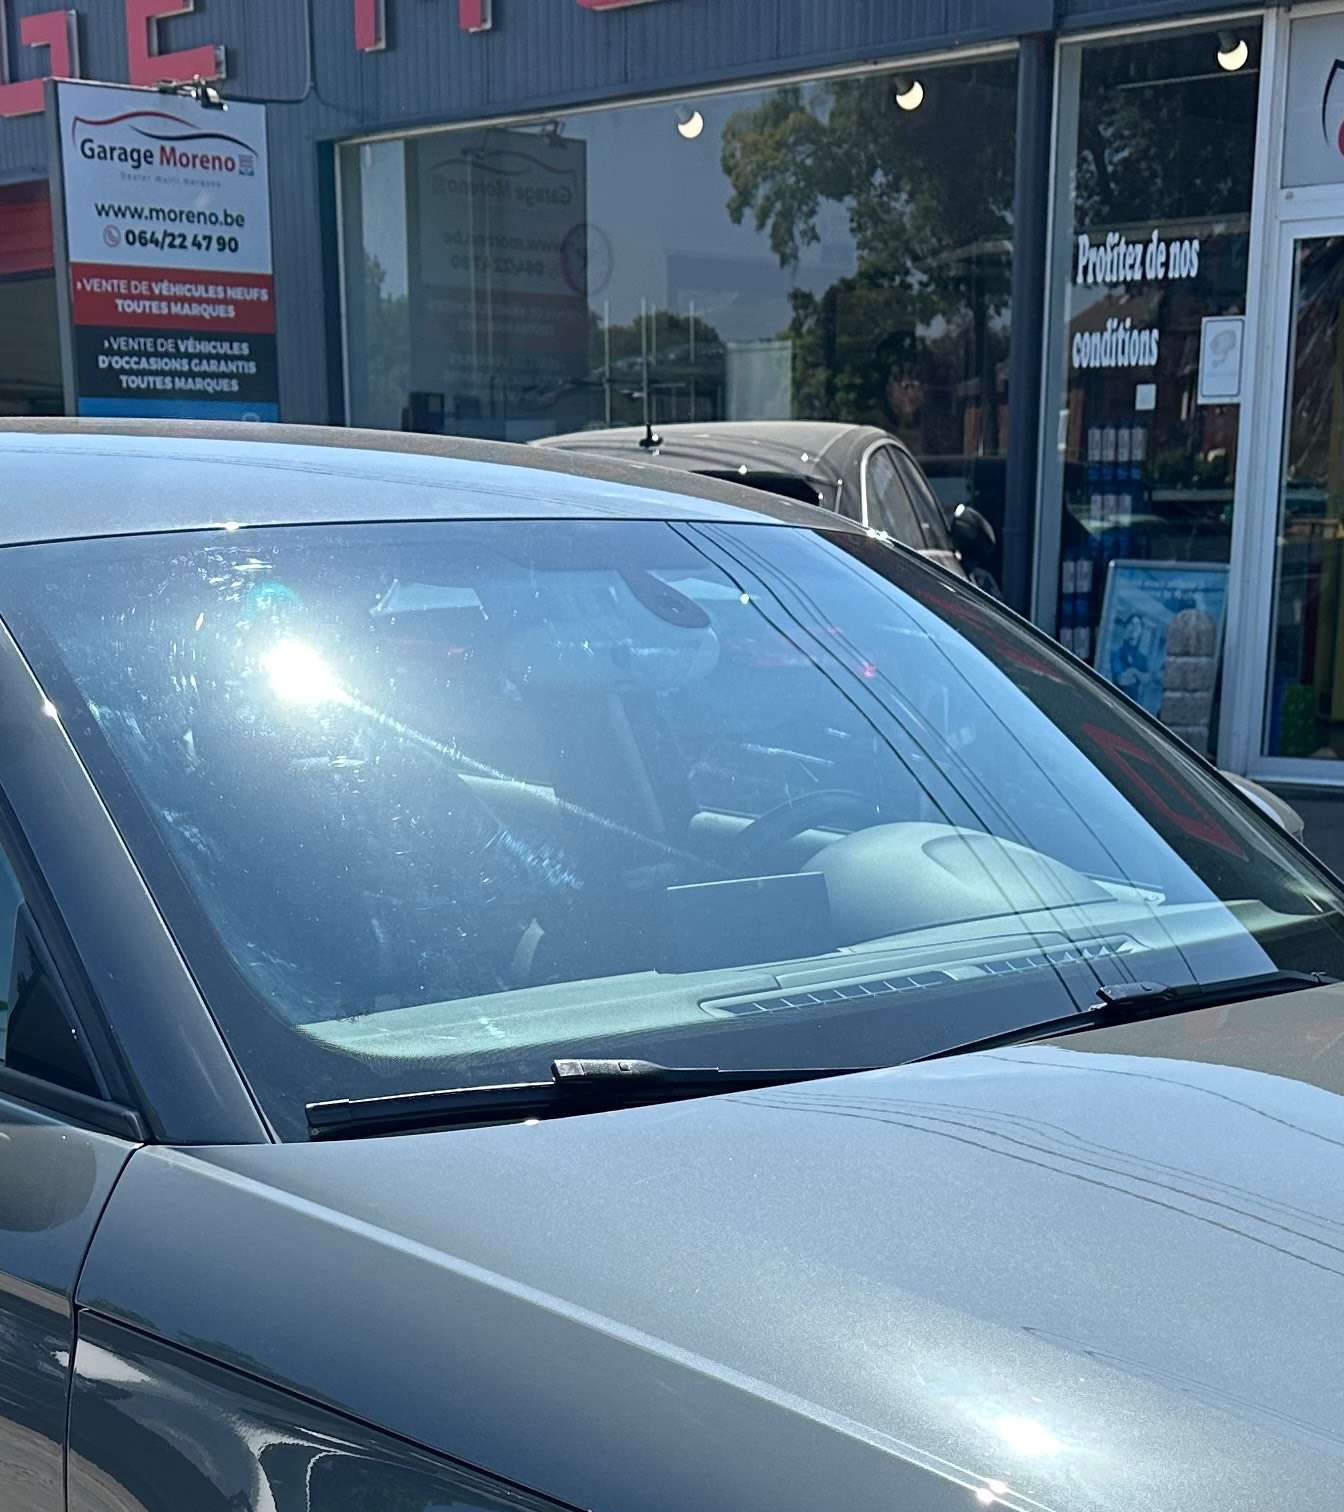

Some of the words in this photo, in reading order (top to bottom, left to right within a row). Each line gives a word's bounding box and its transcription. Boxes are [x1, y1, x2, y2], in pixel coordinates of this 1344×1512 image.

[79, 138, 154, 169] Garage
[159, 145, 236, 172] Moreno
[94, 202, 246, 228] www.moreno.be
[125, 229, 188, 250] 064/22
[191, 235, 213, 251] 47
[217, 236, 240, 252] 90
[1076, 231, 1143, 284] Profitez
[1145, 229, 1167, 280] de
[1168, 239, 1200, 279] nos
[82, 278, 133, 293] VENTE
[134, 281, 150, 294] DE
[152, 280, 225, 298] VÉHICULES
[226, 285, 268, 301] NEUFS
[115, 299, 169, 314] TOUTES
[170, 302, 235, 319] MARQUES
[110, 336, 154, 351] VENTE
[157, 338, 176, 352] DE
[177, 338, 249, 355] VÉHICULES
[1072, 316, 1159, 368] conditions
[98, 355, 189, 371] D'OCCASIONS
[191, 358, 257, 373] GARANTIS
[120, 375, 173, 389] TOUTES
[174, 377, 239, 394] MARQUES
